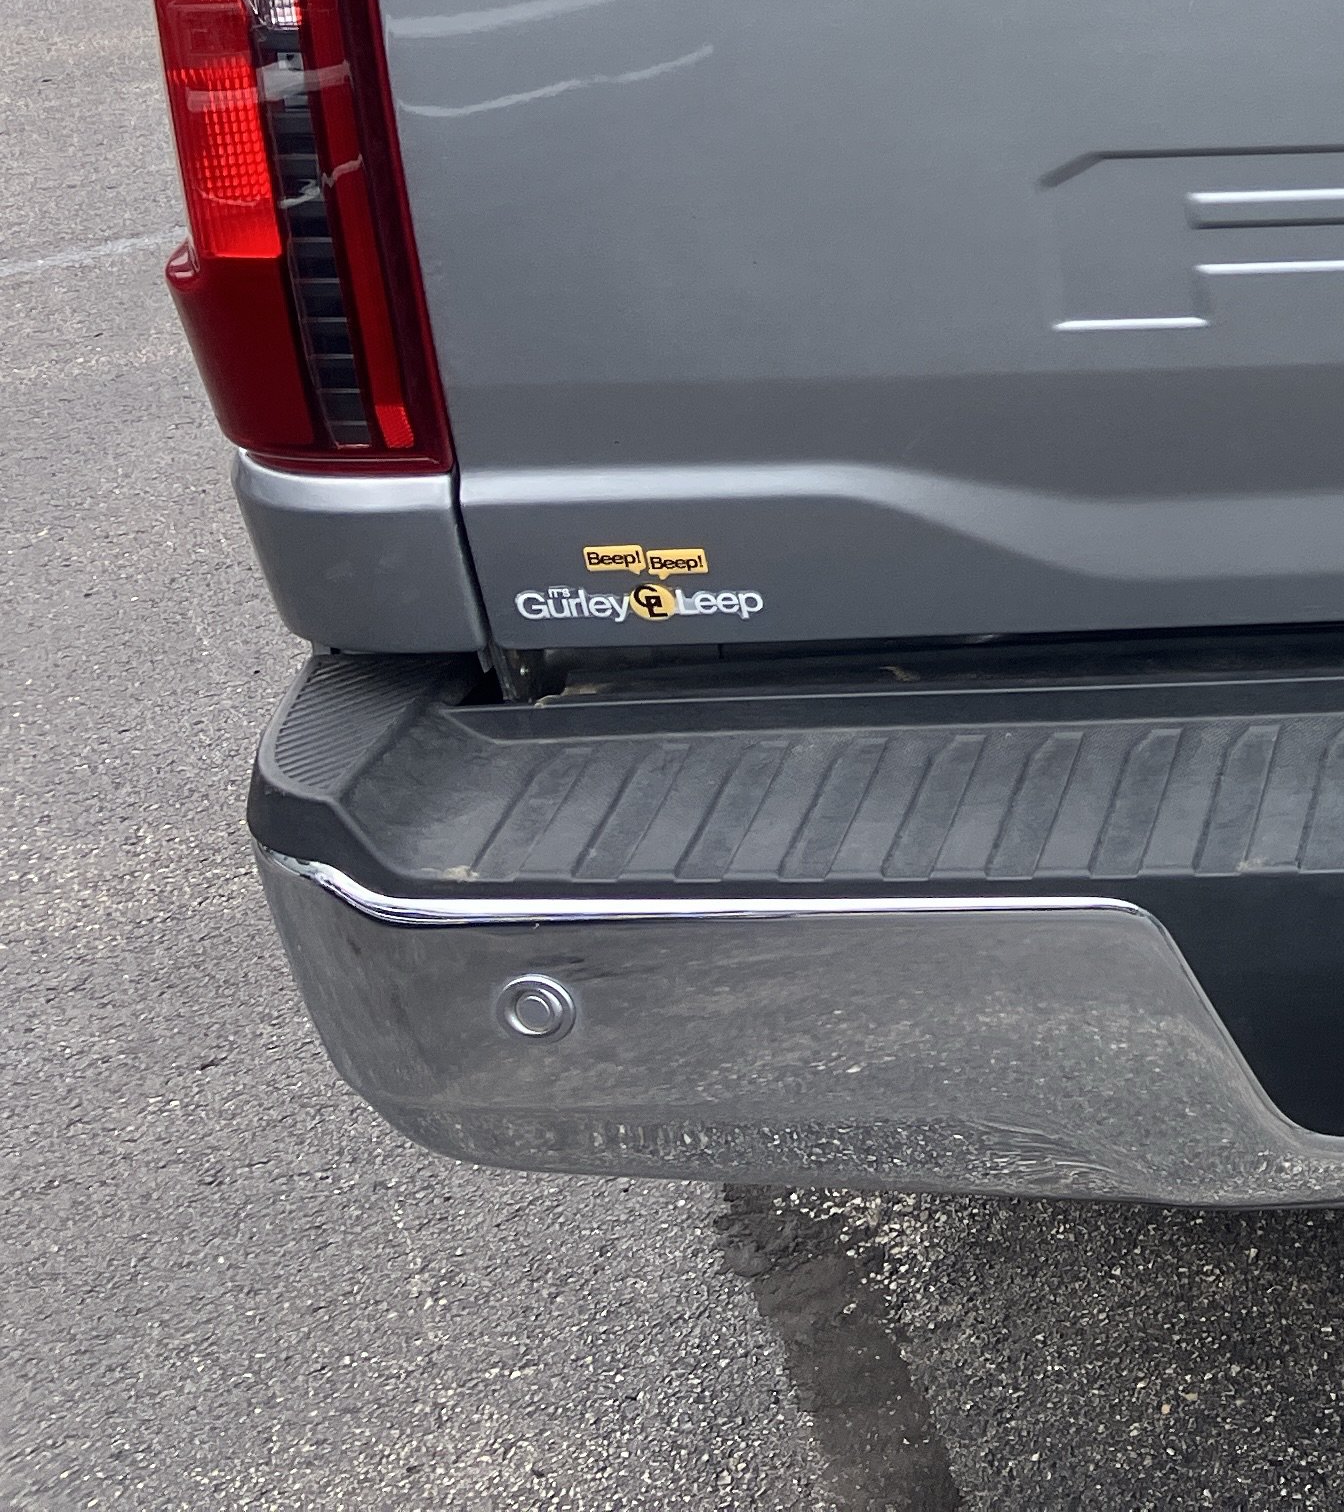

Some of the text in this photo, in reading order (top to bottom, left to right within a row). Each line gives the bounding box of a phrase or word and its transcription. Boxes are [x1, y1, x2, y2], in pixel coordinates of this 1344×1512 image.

[586, 551, 704, 571] Beep! Beep!
[516, 589, 630, 622] Gurley
[675, 589, 763, 619] Leep
